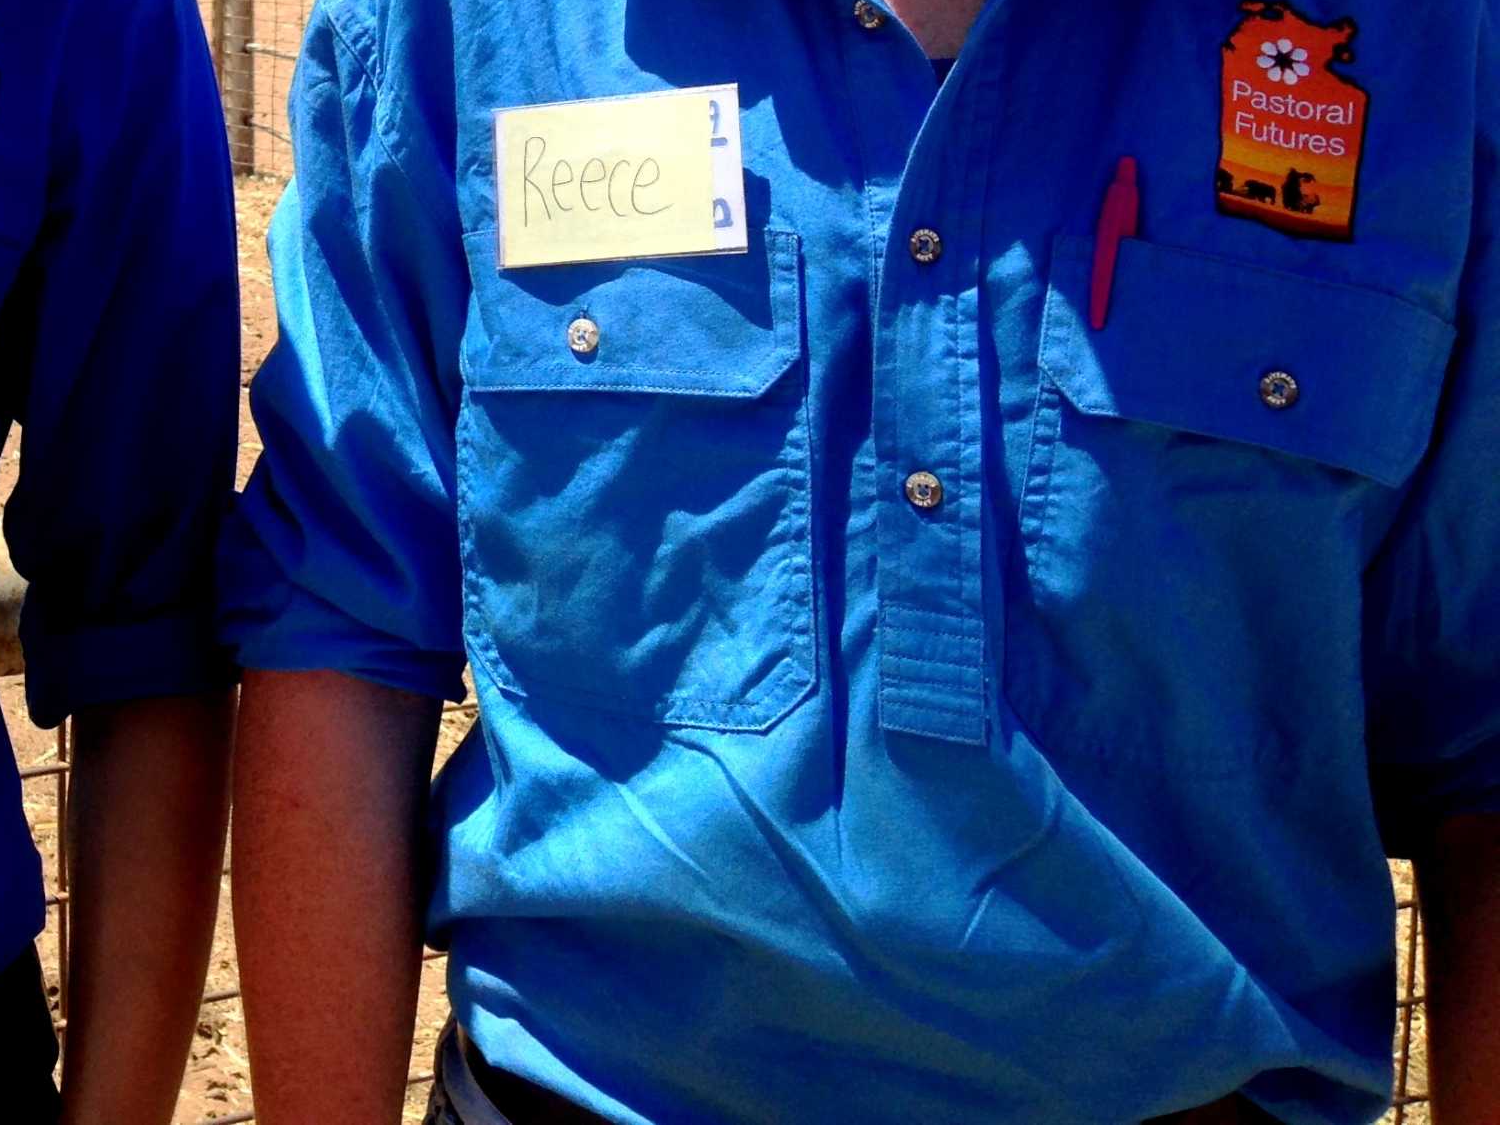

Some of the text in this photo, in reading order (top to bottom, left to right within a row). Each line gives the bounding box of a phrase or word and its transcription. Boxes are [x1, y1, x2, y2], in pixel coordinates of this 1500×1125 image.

[1232, 80, 1354, 125] Pastoral
[1235, 111, 1346, 156] Futures
[524, 136, 674, 227] Reece
